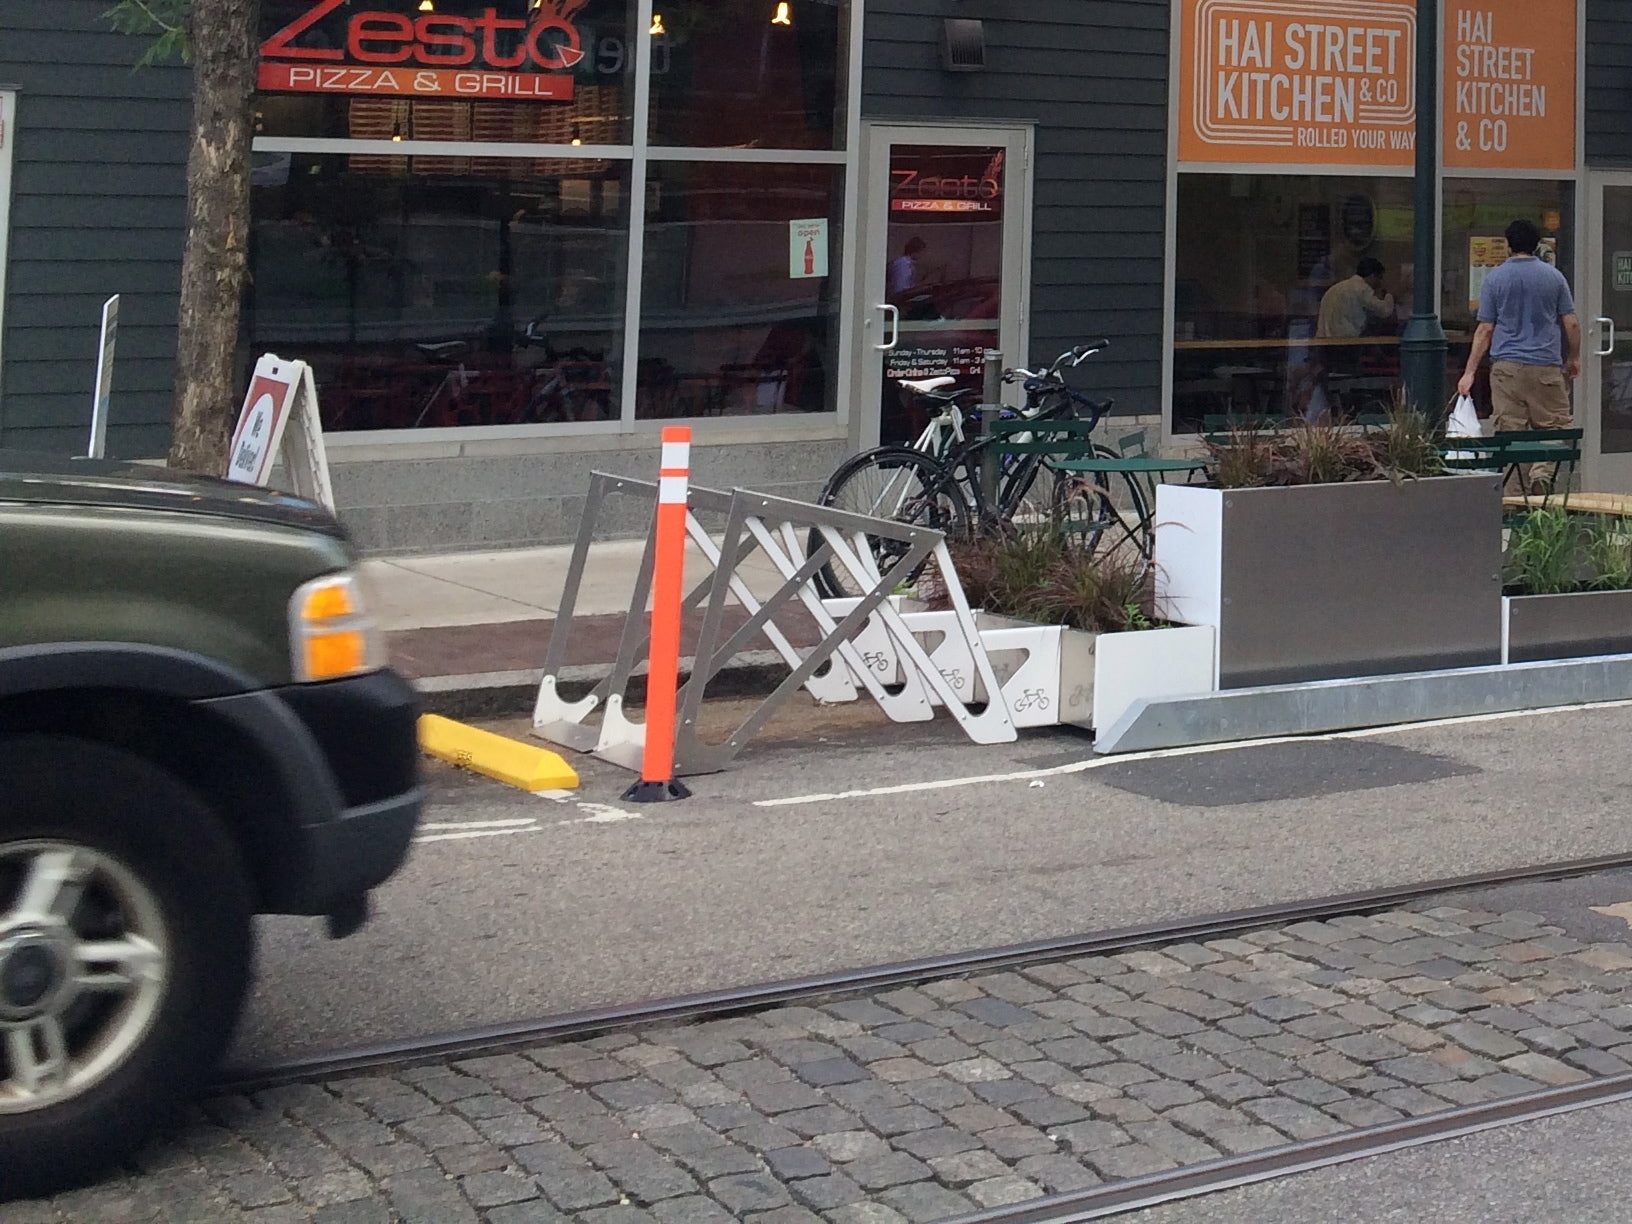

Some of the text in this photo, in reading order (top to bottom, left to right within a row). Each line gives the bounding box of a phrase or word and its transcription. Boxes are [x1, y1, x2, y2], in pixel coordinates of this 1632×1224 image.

[1457, 9, 1493, 44] HAI
[1218, 18, 1401, 75] HAI STREET
[1456, 44, 1536, 80] STREET
[289, 67, 553, 97] PIZZA & GRILL
[1217, 70, 1398, 124] KITCHEN & CO
[1456, 80, 1546, 117] KITCHEN
[1297, 127, 1416, 150] ROLLED YOUR WAY
[1455, 118, 1508, 152] & CO
[891, 170, 1000, 198] Zesto
[901, 201, 939, 210] PIZZA
[957, 202, 992, 211] GRILL
[1617, 258, 1631, 270] HAI
